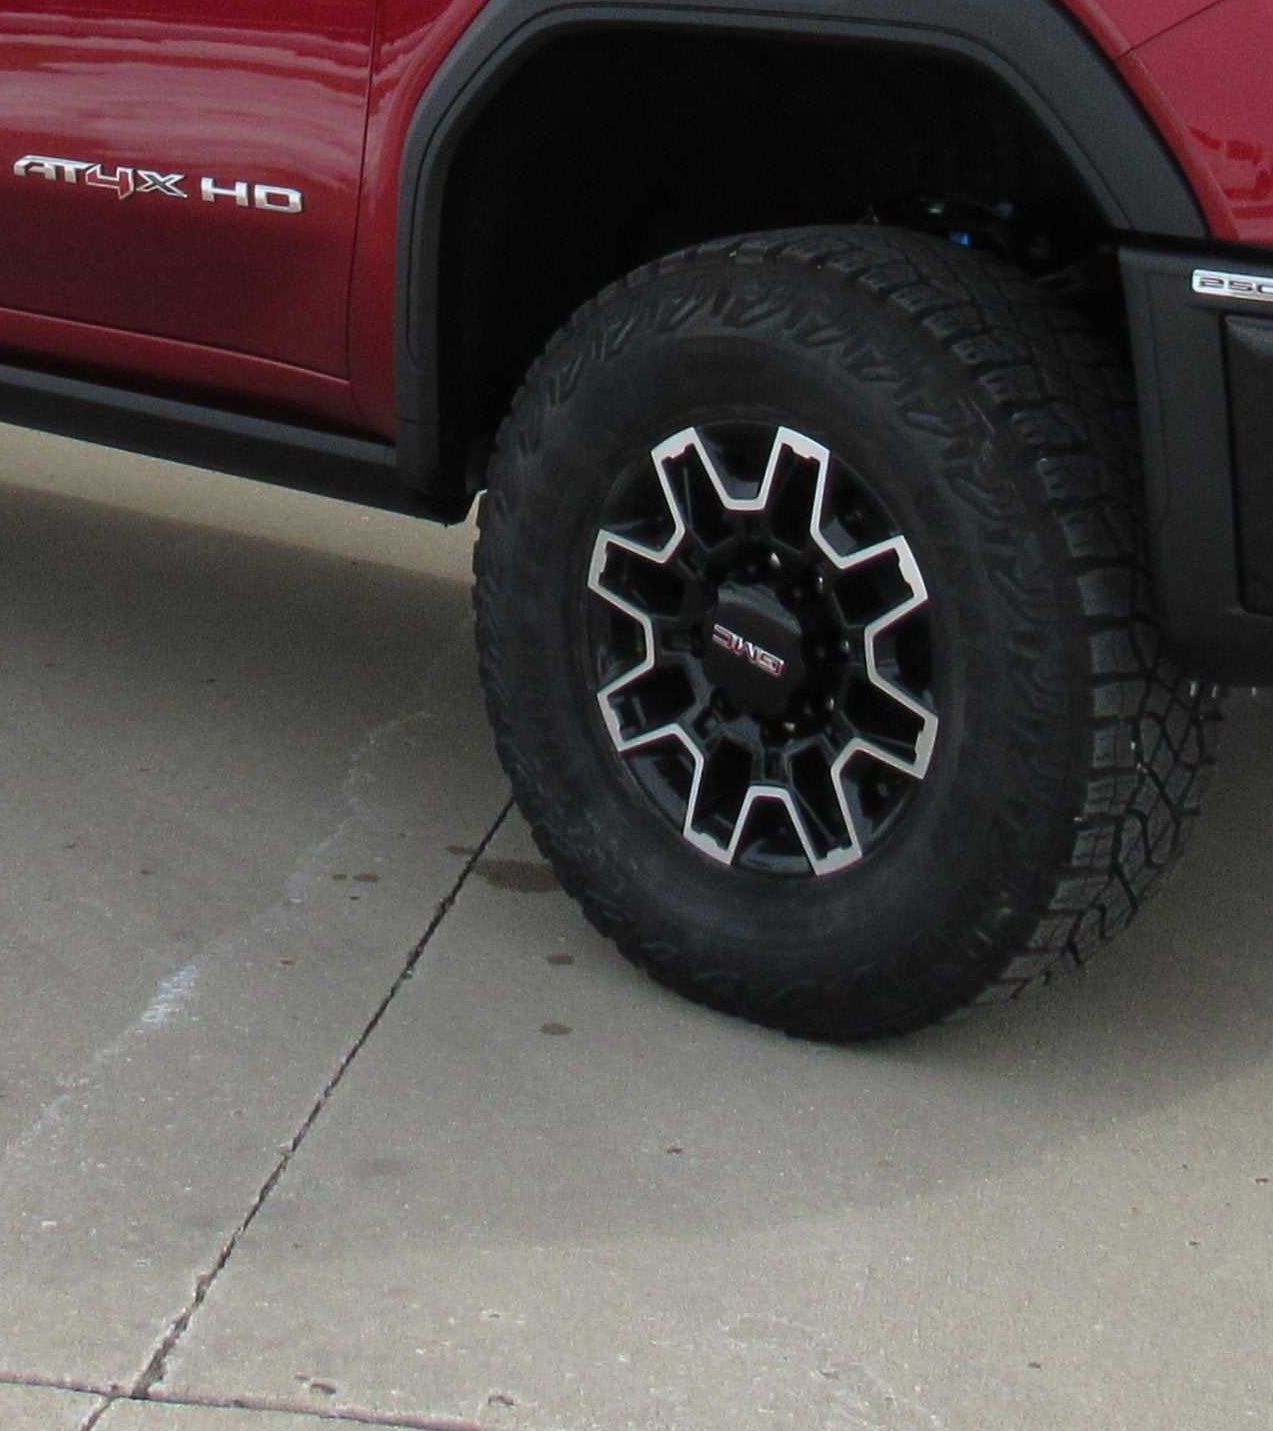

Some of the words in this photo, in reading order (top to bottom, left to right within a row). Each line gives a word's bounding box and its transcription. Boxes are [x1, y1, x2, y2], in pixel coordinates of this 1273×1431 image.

[13, 154, 188, 200] AT4X
[200, 176, 303, 214] HD
[712, 623, 786, 677] GMC
